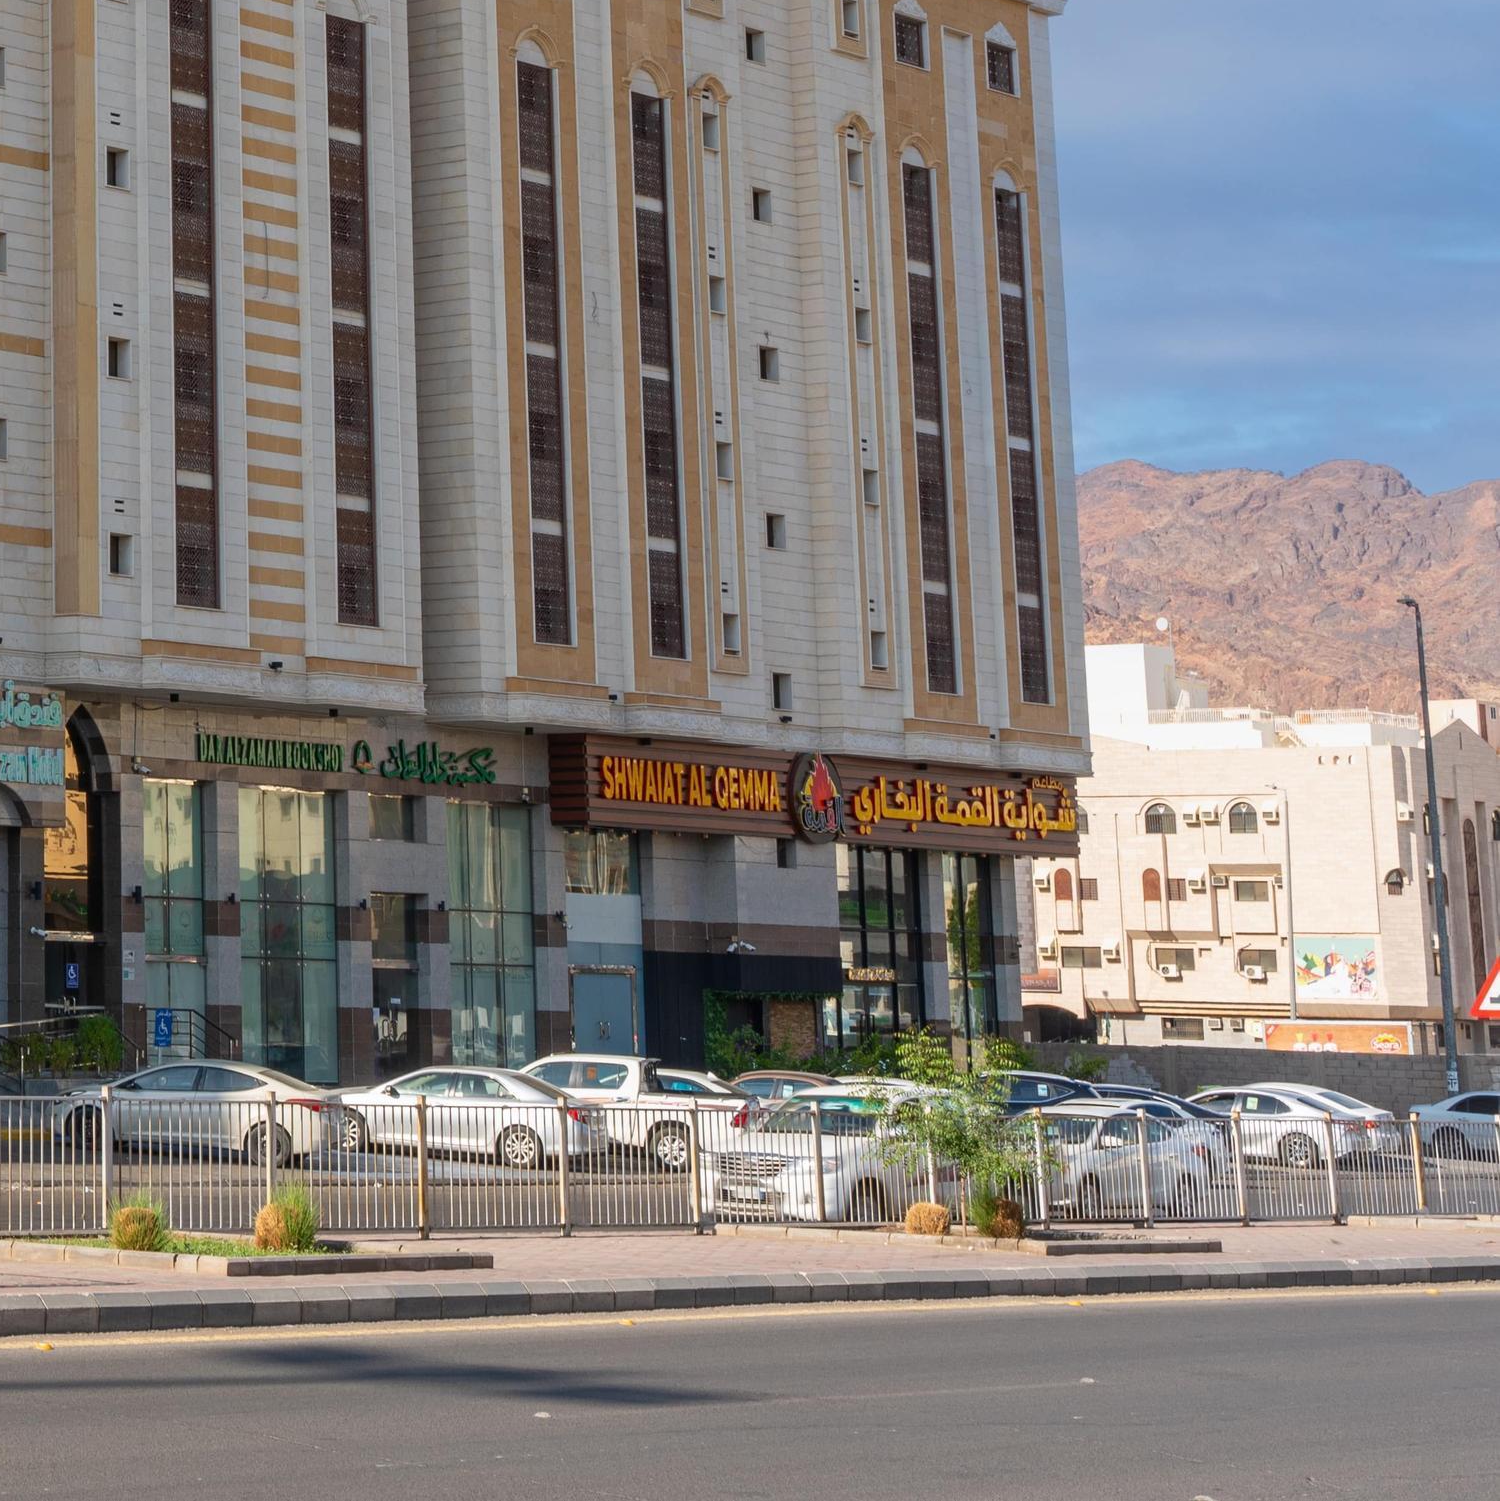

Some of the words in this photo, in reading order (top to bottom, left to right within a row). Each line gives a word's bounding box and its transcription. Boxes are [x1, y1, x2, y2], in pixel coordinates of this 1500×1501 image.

[13, 691, 63, 728] فندق
[198, 733, 224, 763] DAR
[225, 735, 285, 768] ALZAMAN
[601, 755, 684, 805] SHWAIAT
[688, 763, 712, 807] AL
[714, 765, 782, 813] QEMMA
[854, 775, 932, 835] البخاري
[934, 782, 1000, 827] القمة
[1031, 776, 1064, 791] مطاعم
[1003, 788, 1076, 840] شواية
